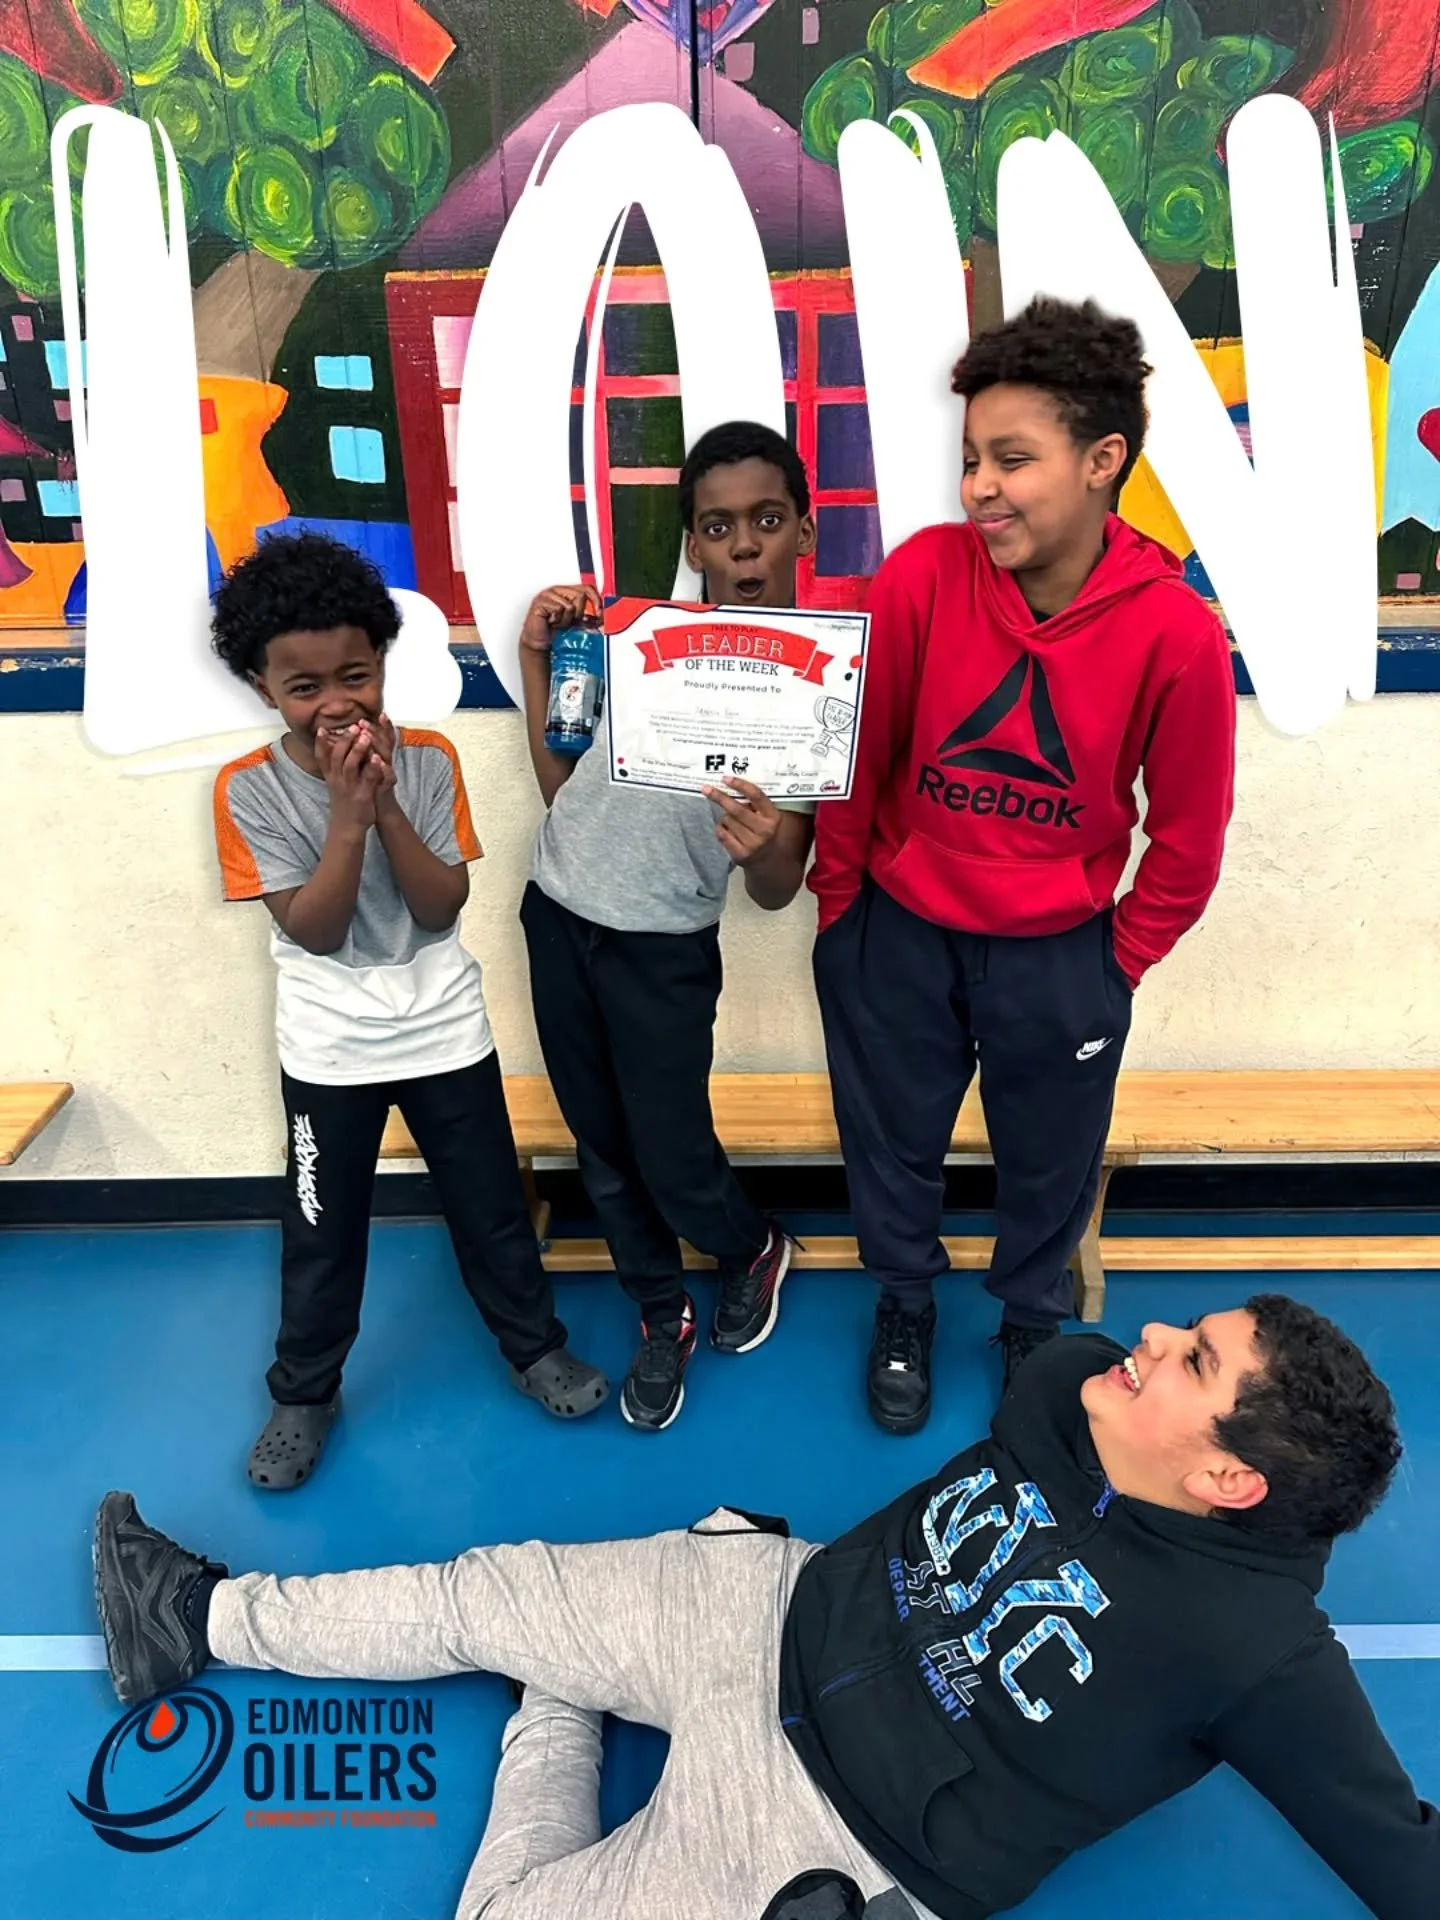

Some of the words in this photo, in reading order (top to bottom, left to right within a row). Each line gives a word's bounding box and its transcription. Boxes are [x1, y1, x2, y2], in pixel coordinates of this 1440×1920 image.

[685, 632, 784, 659] LEADER
[685, 658, 703, 670] OF
[707, 659, 735, 672] THE
[739, 660, 779, 676] WEEK
[684, 680, 718, 691] Proudly
[721, 683, 768, 693] Presented
[915, 763, 1088, 829] Reebok
